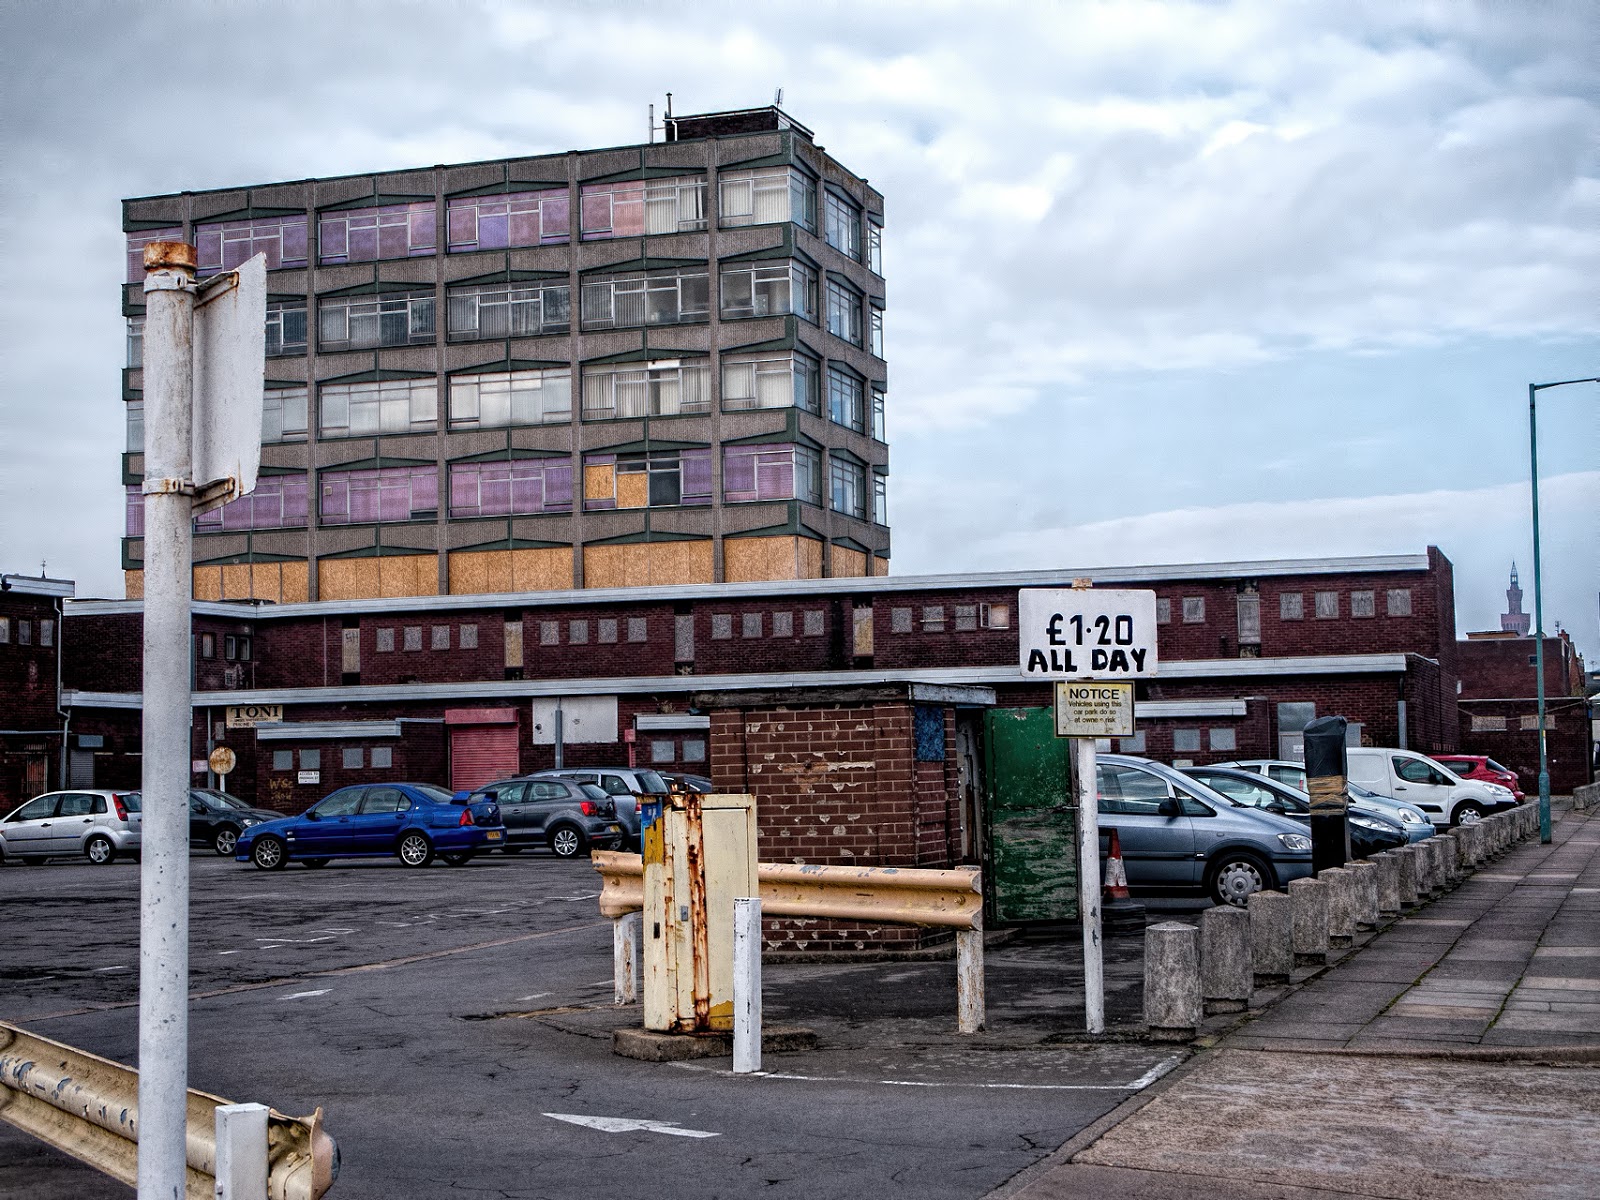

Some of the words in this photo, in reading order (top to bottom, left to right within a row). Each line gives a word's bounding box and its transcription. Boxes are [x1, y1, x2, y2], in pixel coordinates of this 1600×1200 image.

[1028, 649, 1078, 672] ALL
[1091, 648, 1147, 672] DAY
[1069, 688, 1120, 699] NOTICE
[231, 706, 280, 718] TONI
